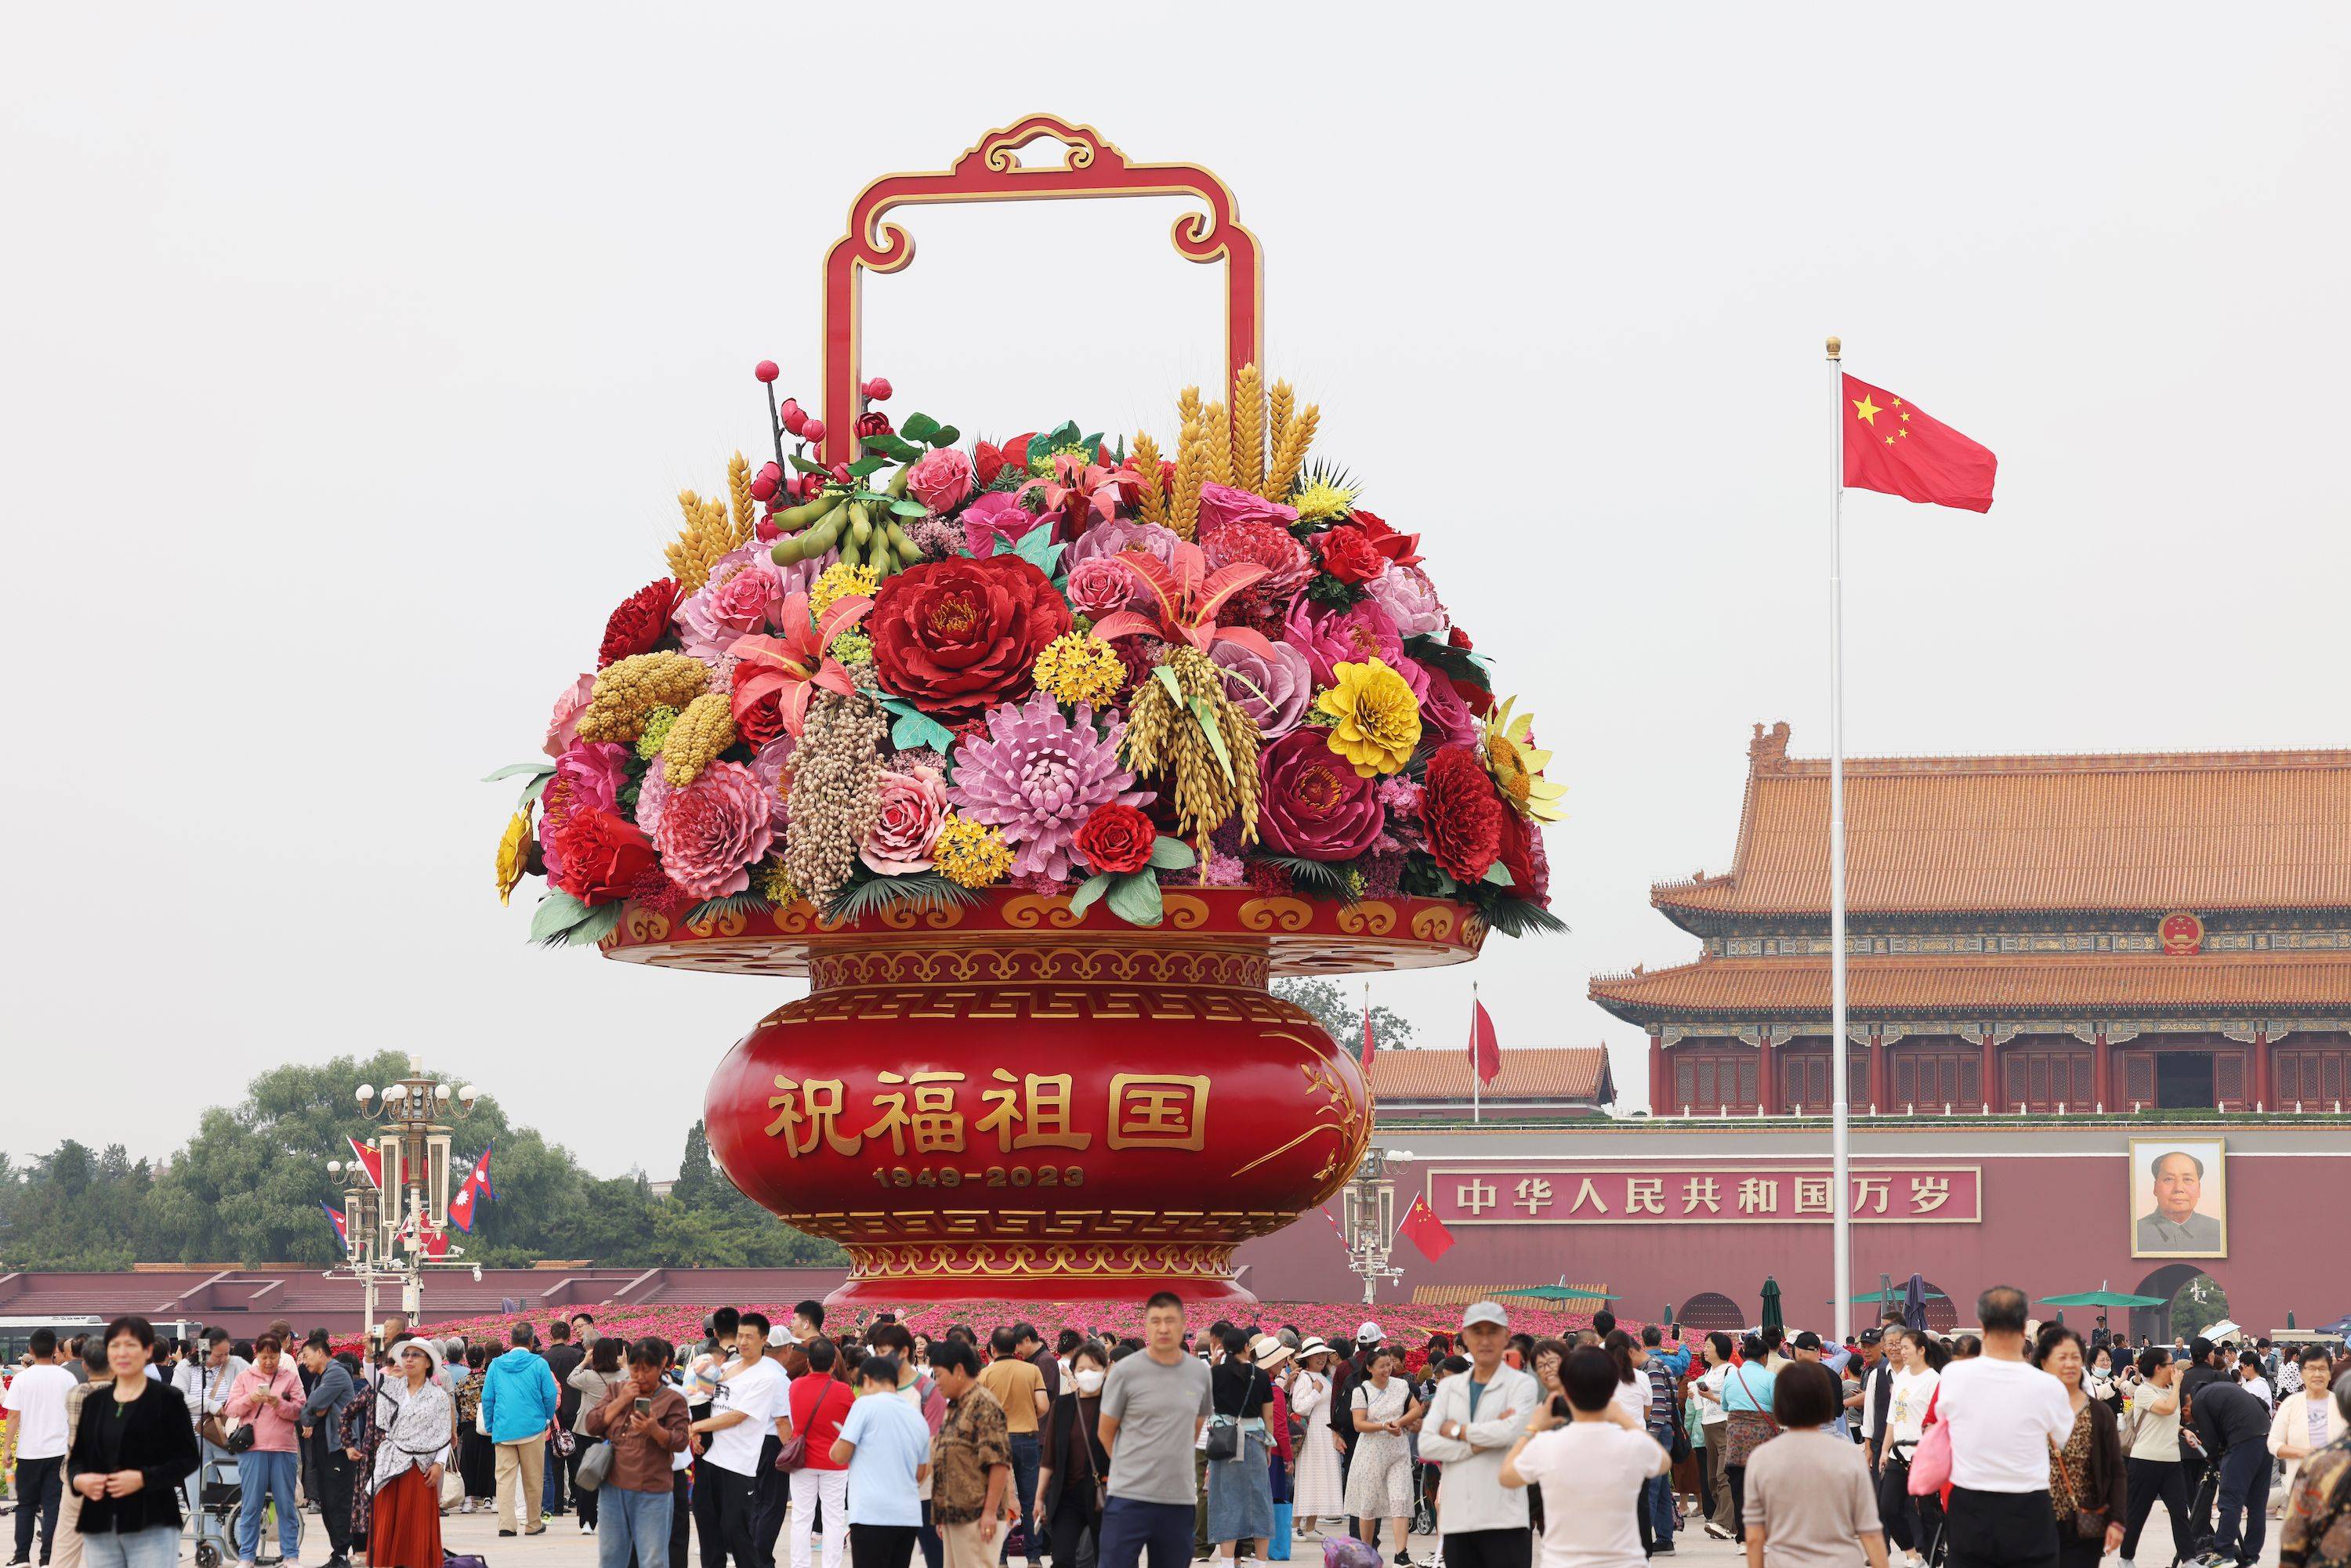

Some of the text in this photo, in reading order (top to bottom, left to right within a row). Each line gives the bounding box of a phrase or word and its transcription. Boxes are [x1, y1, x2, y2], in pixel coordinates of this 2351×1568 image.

[764, 1069, 1211, 1157] 祝福祖国
[872, 1165, 1084, 1187] 1949-2023
[1456, 1176, 1951, 1215] 中华人民共和国万岁
